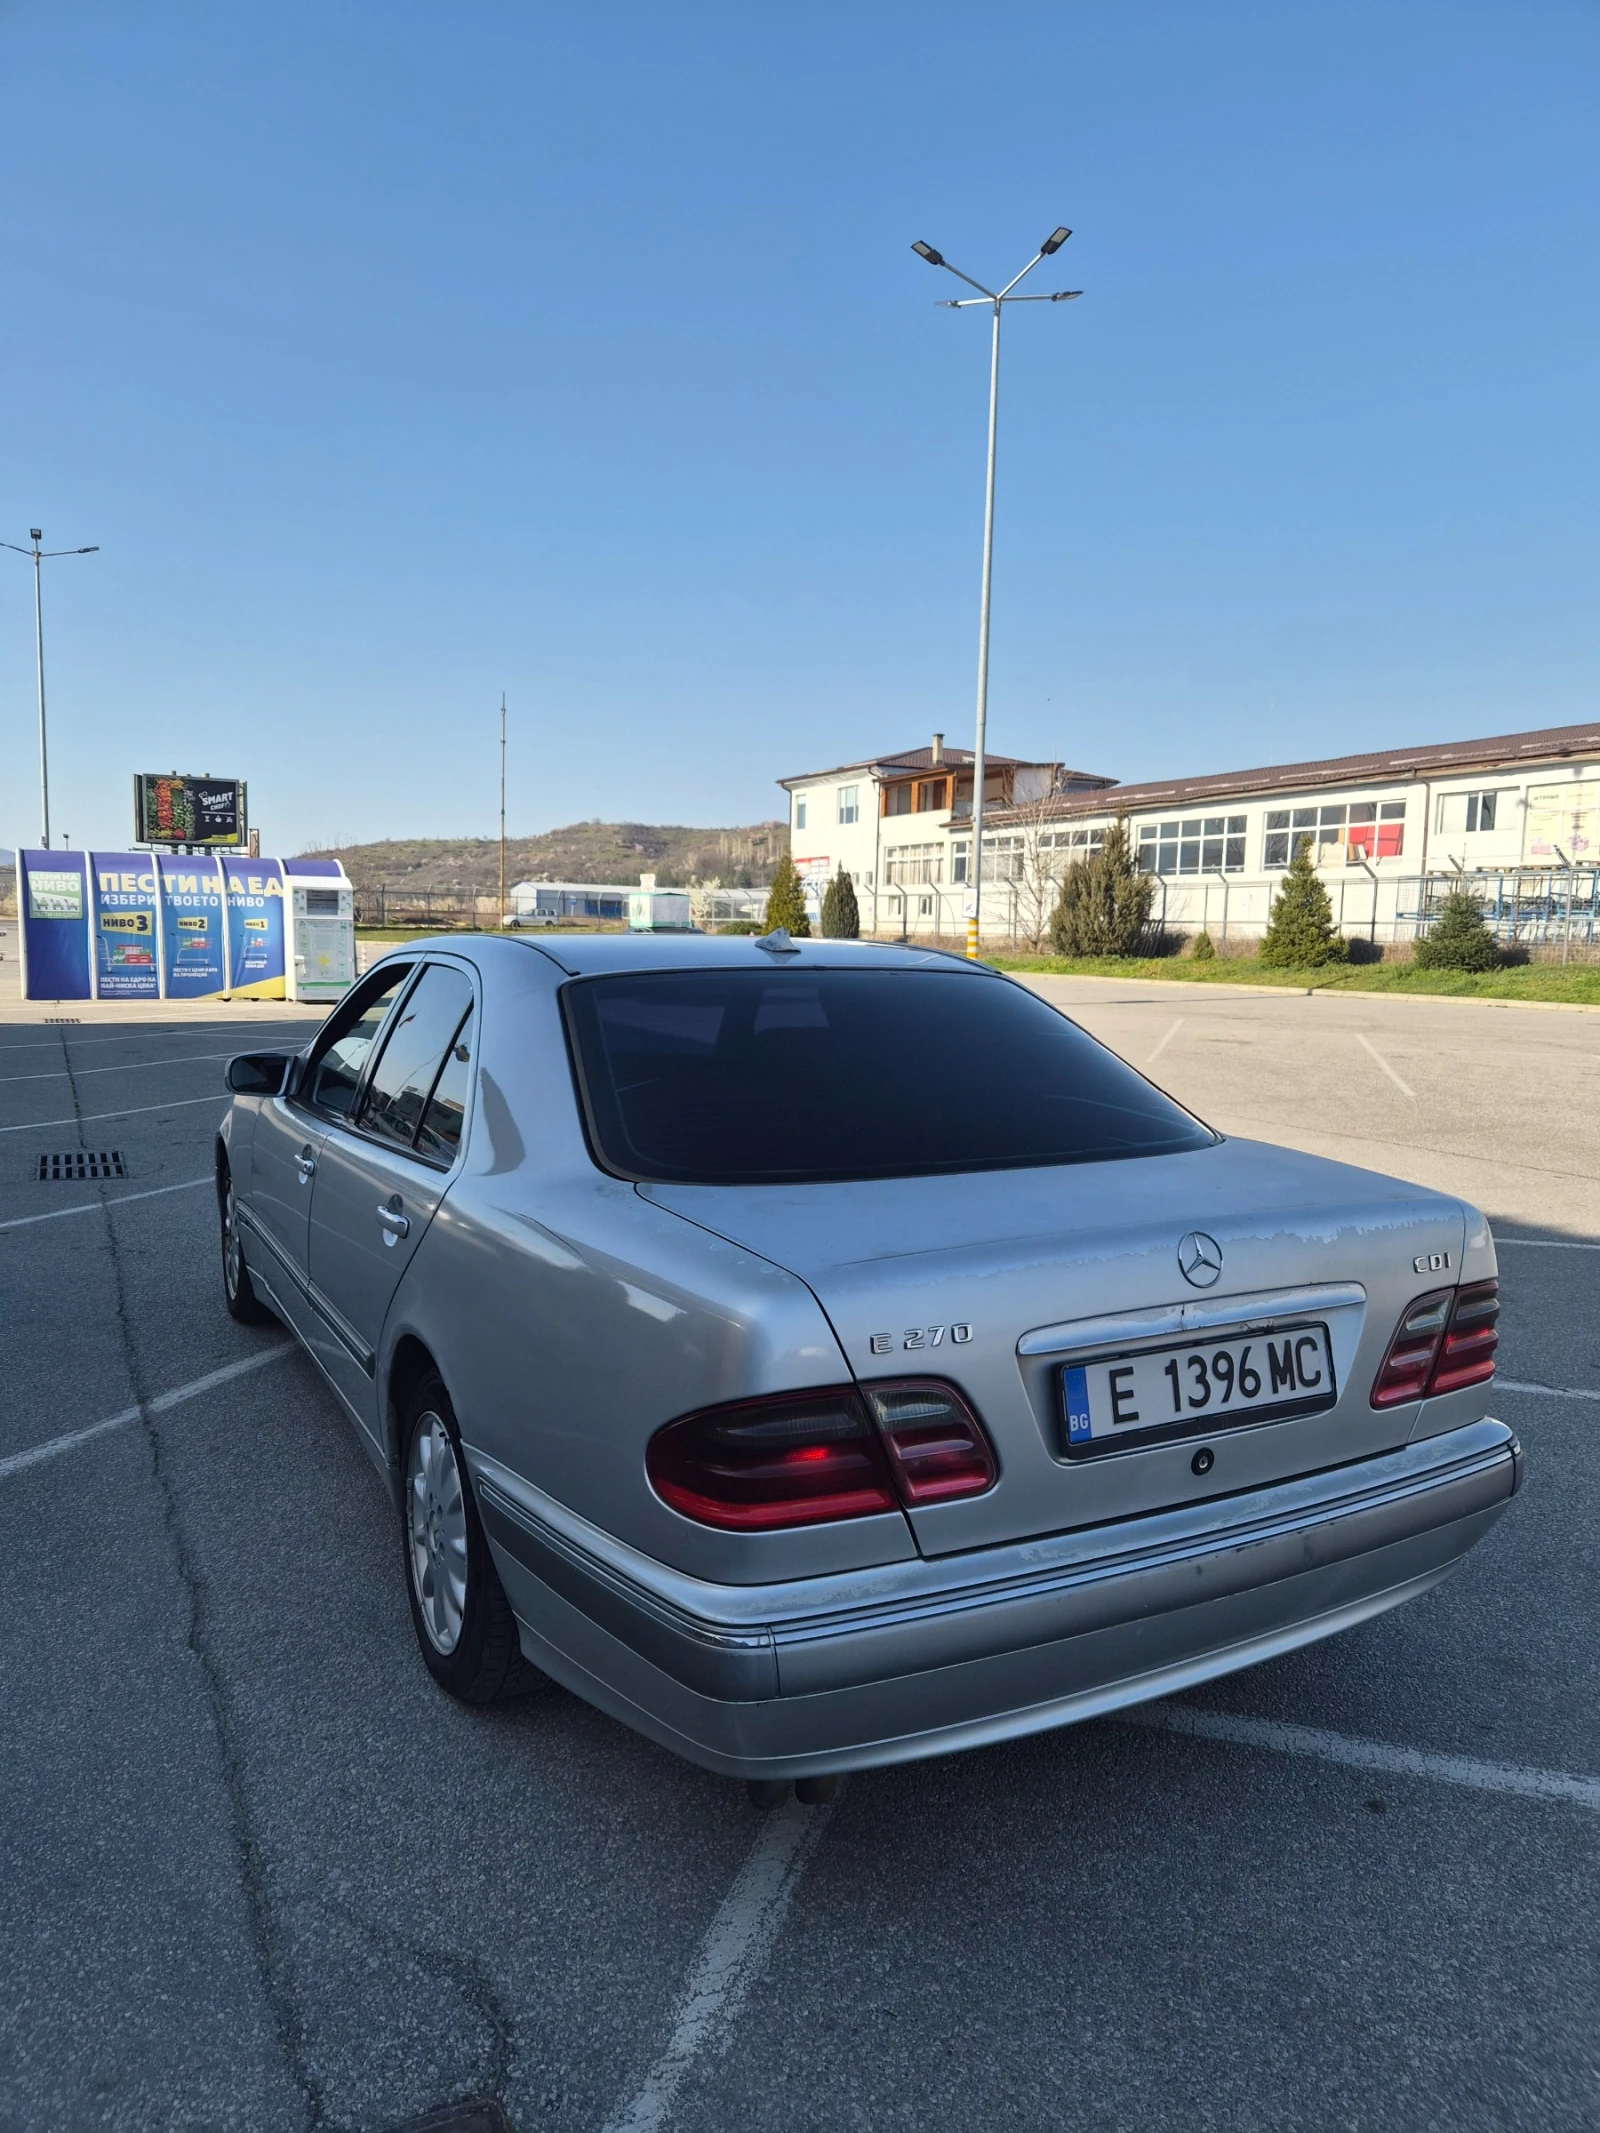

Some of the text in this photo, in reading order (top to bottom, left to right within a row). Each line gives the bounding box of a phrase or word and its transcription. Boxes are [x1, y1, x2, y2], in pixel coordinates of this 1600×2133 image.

[202, 792, 233, 806] SMART
[210, 803, 225, 811] CHEF
[31, 873, 61, 881] ЦЕНИ
[99, 873, 198, 894] ПЕСТИ
[202, 876, 246, 894] НА
[31, 880, 79, 891] НИВО
[101, 894, 264, 907] ИЗБЕРИ ТВОЕТО НИВО
[103, 915, 148, 931] НИВО 3
[198, 919, 206, 929] 2
[1412, 1252, 1451, 1273] CDI
[870, 1323, 974, 1355] E 270
[1109, 1336, 1321, 1424] E 1396 MC
[1069, 1413, 1088, 1432] BG
